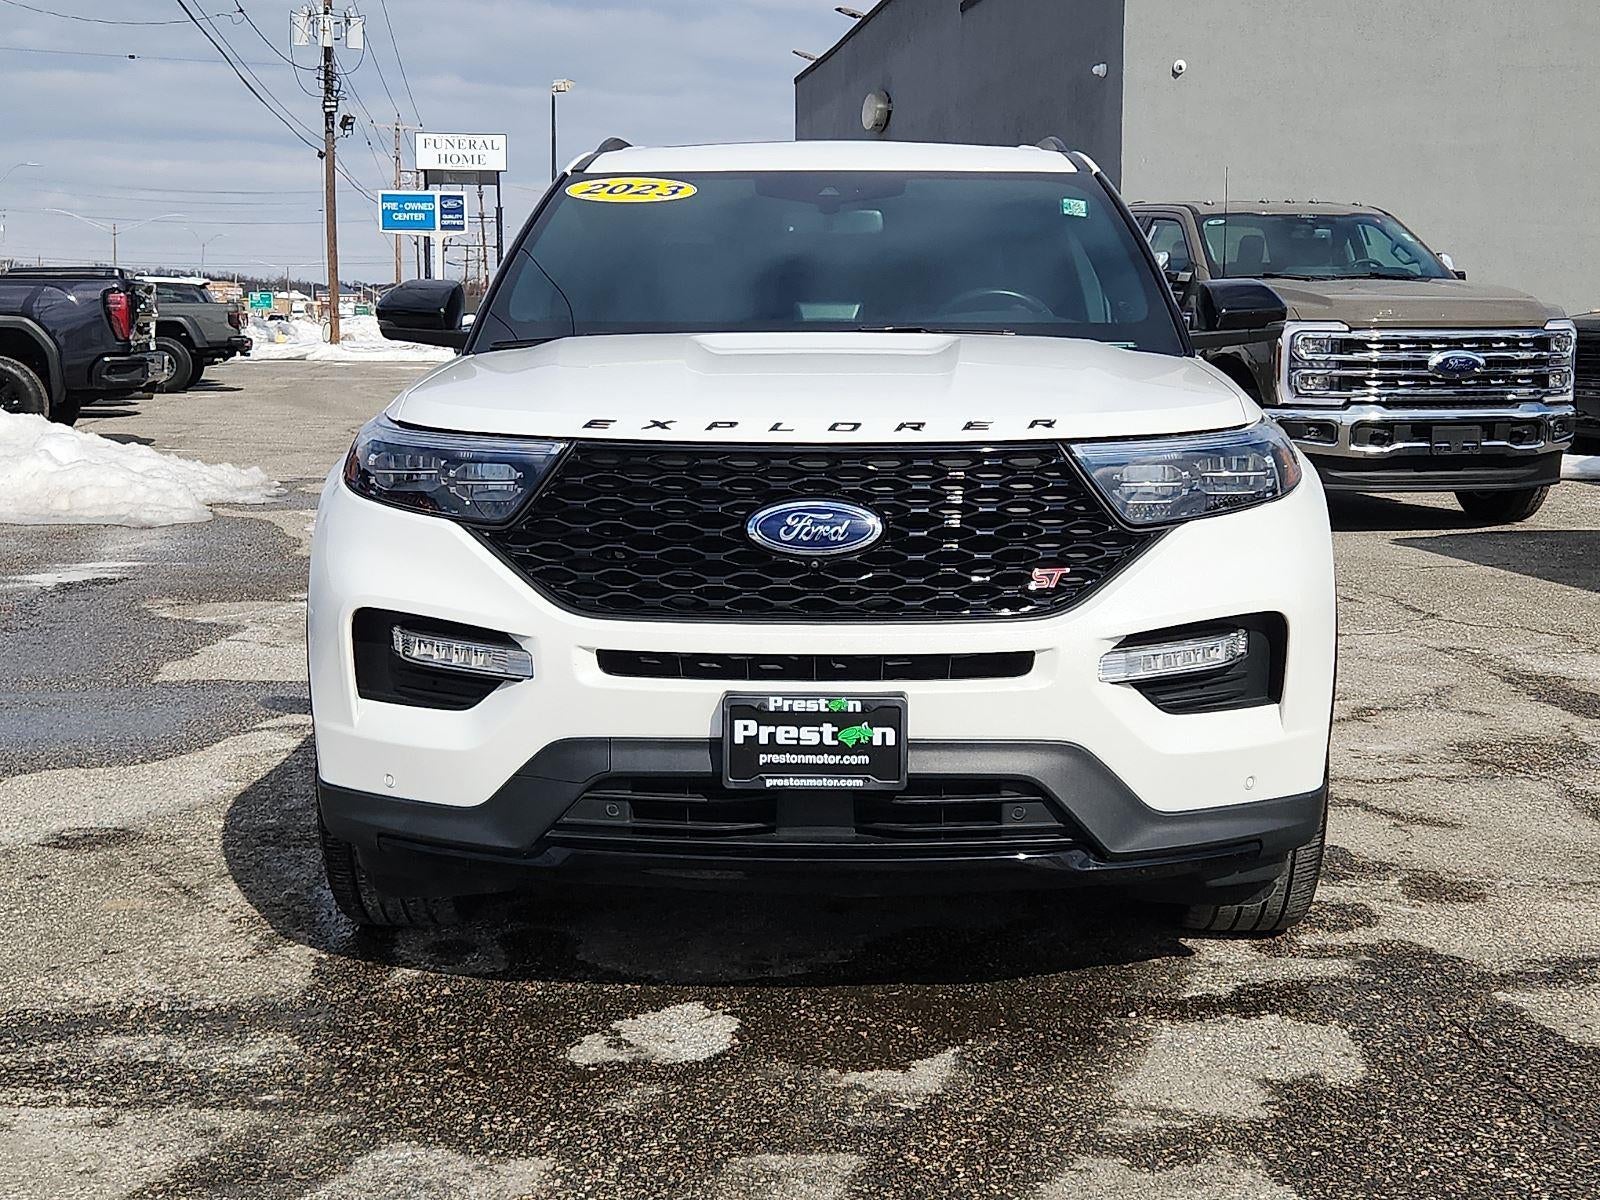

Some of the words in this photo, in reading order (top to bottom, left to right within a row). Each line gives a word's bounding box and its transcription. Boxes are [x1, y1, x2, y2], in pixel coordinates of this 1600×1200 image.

[424, 138, 499, 150] FUNERAL
[438, 154, 486, 165] HOME
[578, 183, 685, 197] 2023
[392, 213, 426, 221] CENTER
[582, 418, 1058, 434] EXPLORER
[779, 512, 852, 541] Ford
[1028, 567, 1071, 590] ST
[768, 696, 862, 712] Prestn
[733, 719, 896, 748] Prestn
[759, 753, 870, 766] prestonmotor.com
[765, 777, 864, 787] prestonmotor.com
